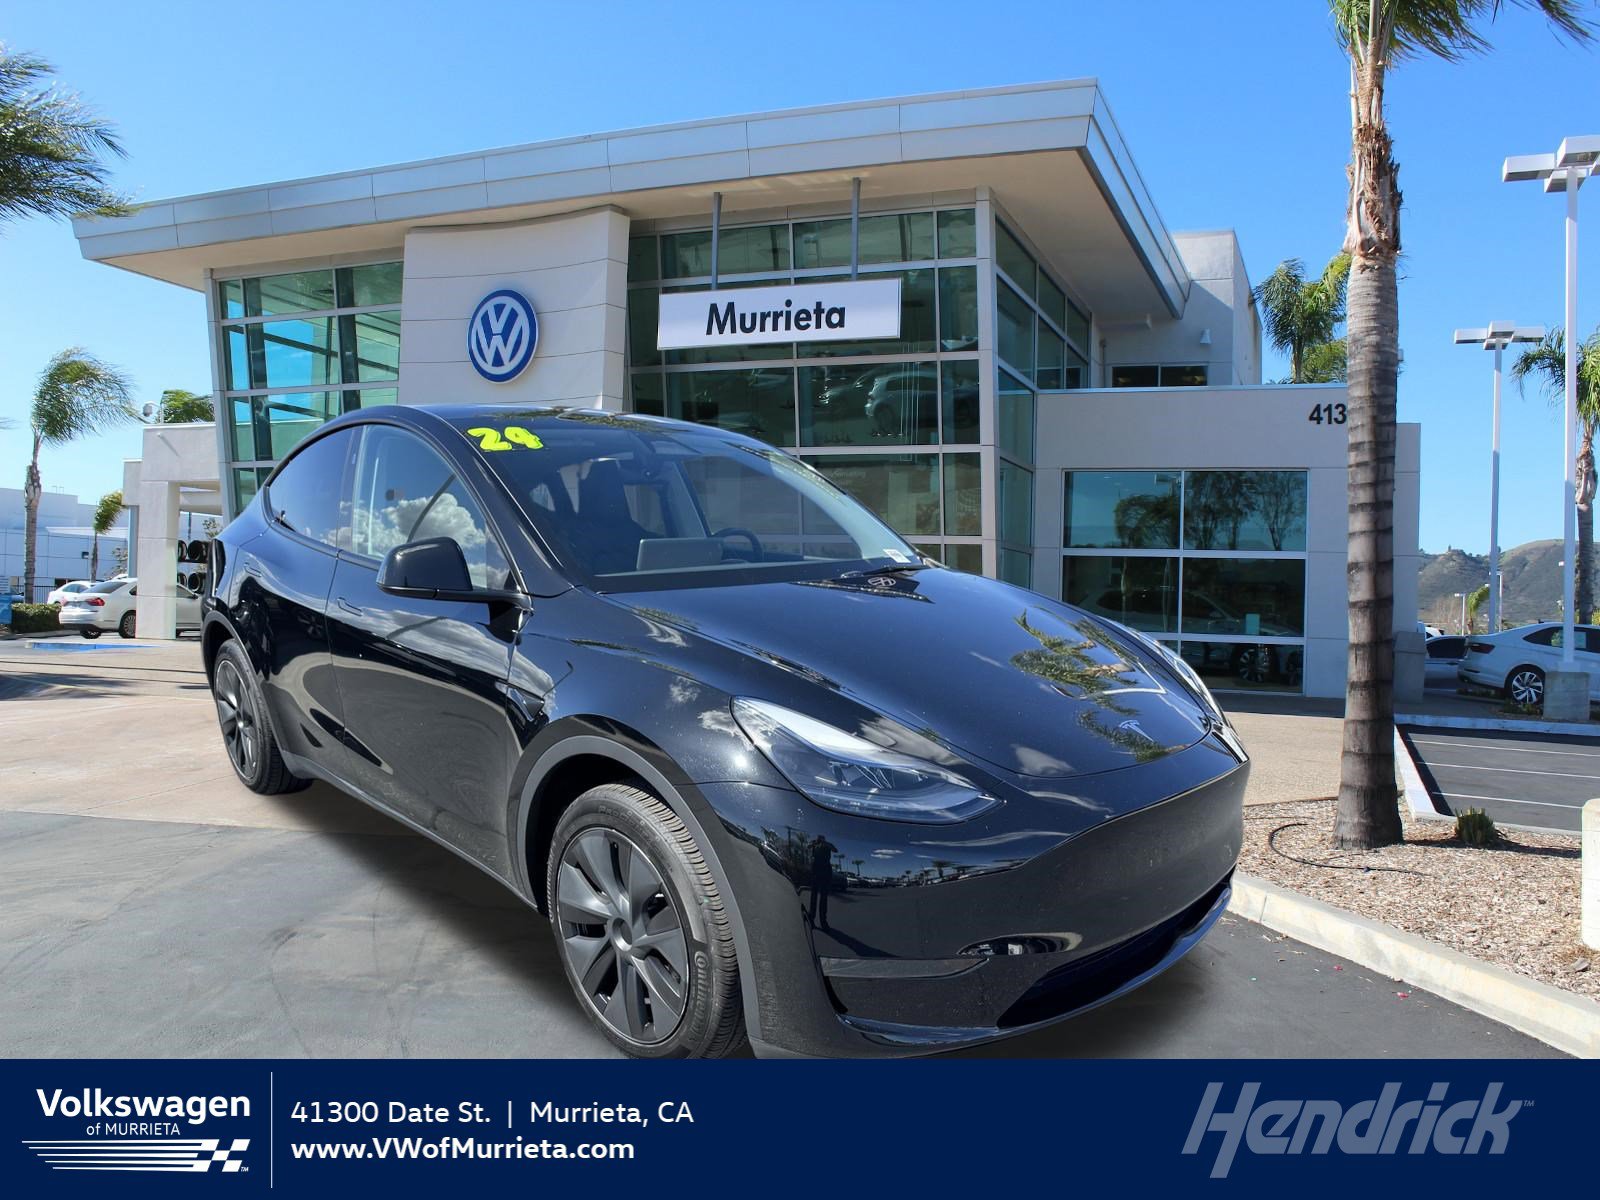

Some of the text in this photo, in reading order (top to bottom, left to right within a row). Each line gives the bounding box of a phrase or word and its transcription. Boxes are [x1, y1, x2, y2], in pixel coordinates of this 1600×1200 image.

[706, 299, 846, 335] Murrieta
[471, 296, 530, 375] VW
[1308, 403, 1347, 425] 413
[467, 426, 543, 451] 24
